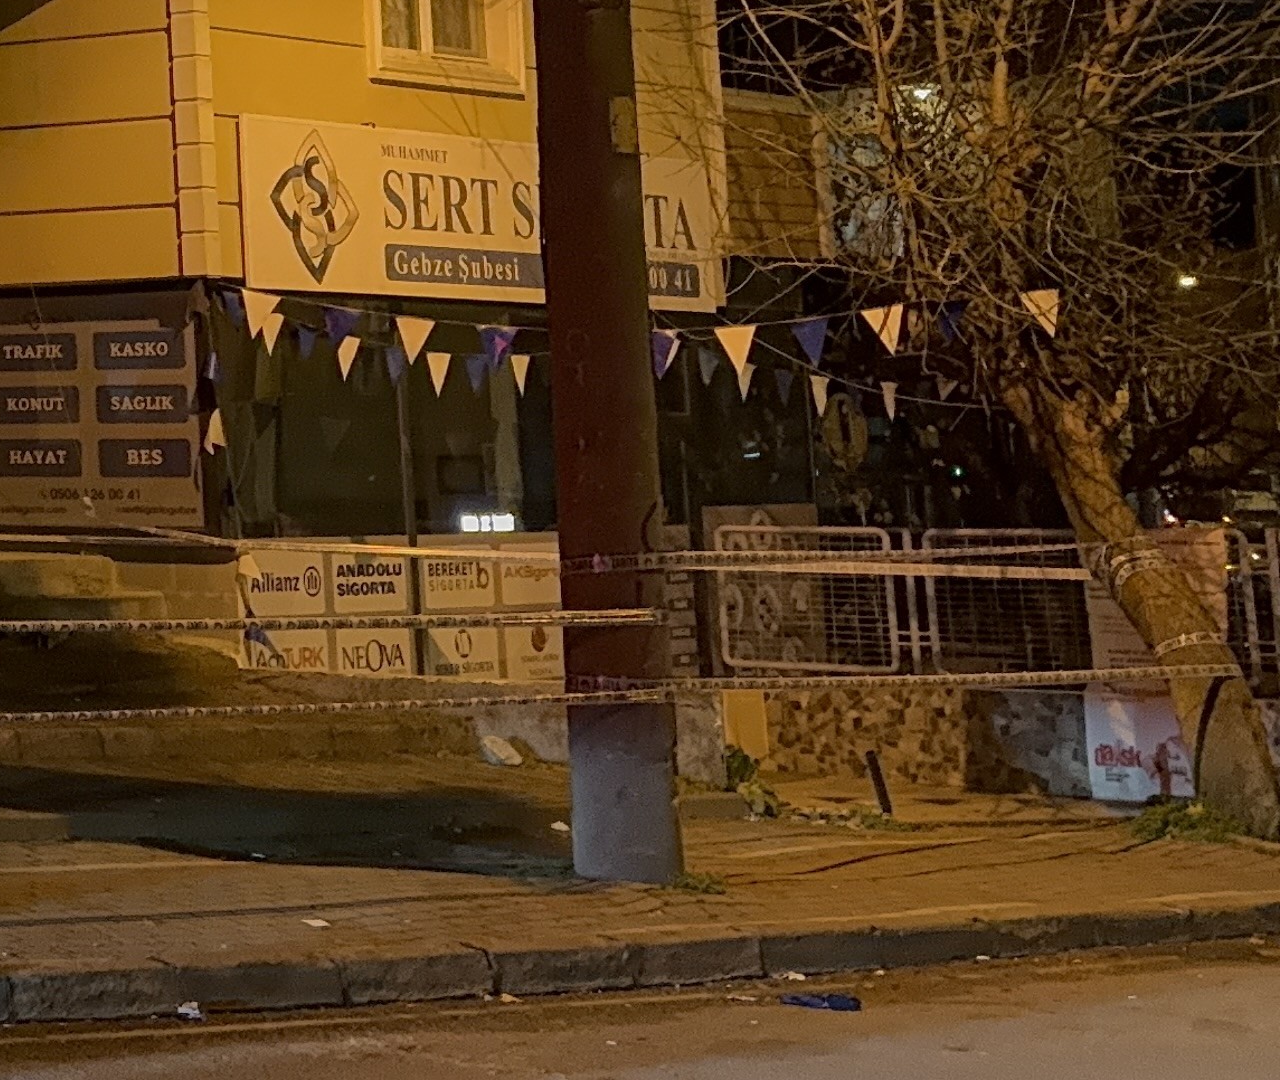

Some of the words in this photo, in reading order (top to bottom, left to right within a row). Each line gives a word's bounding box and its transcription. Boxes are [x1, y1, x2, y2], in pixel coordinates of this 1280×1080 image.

[381, 144, 448, 163] MUHAMMET
[383, 170, 497, 236] SERT
[393, 249, 453, 277] Gebze
[458, 254, 520, 283] Şubesi
[674, 268, 692, 291] 41
[109, 341, 169, 358] KASKO
[6, 397, 65, 412] KONUT
[9, 449, 67, 465] HAYAT
[126, 448, 163, 465] BES
[50, 488, 79, 500] 0506
[336, 563, 402, 577] ANADOLU
[427, 562, 474, 577] BEREKET
[251, 572, 300, 593] Allianz
[336, 580, 397, 596] SİGORTA
[342, 639, 405, 672] NEOVA
